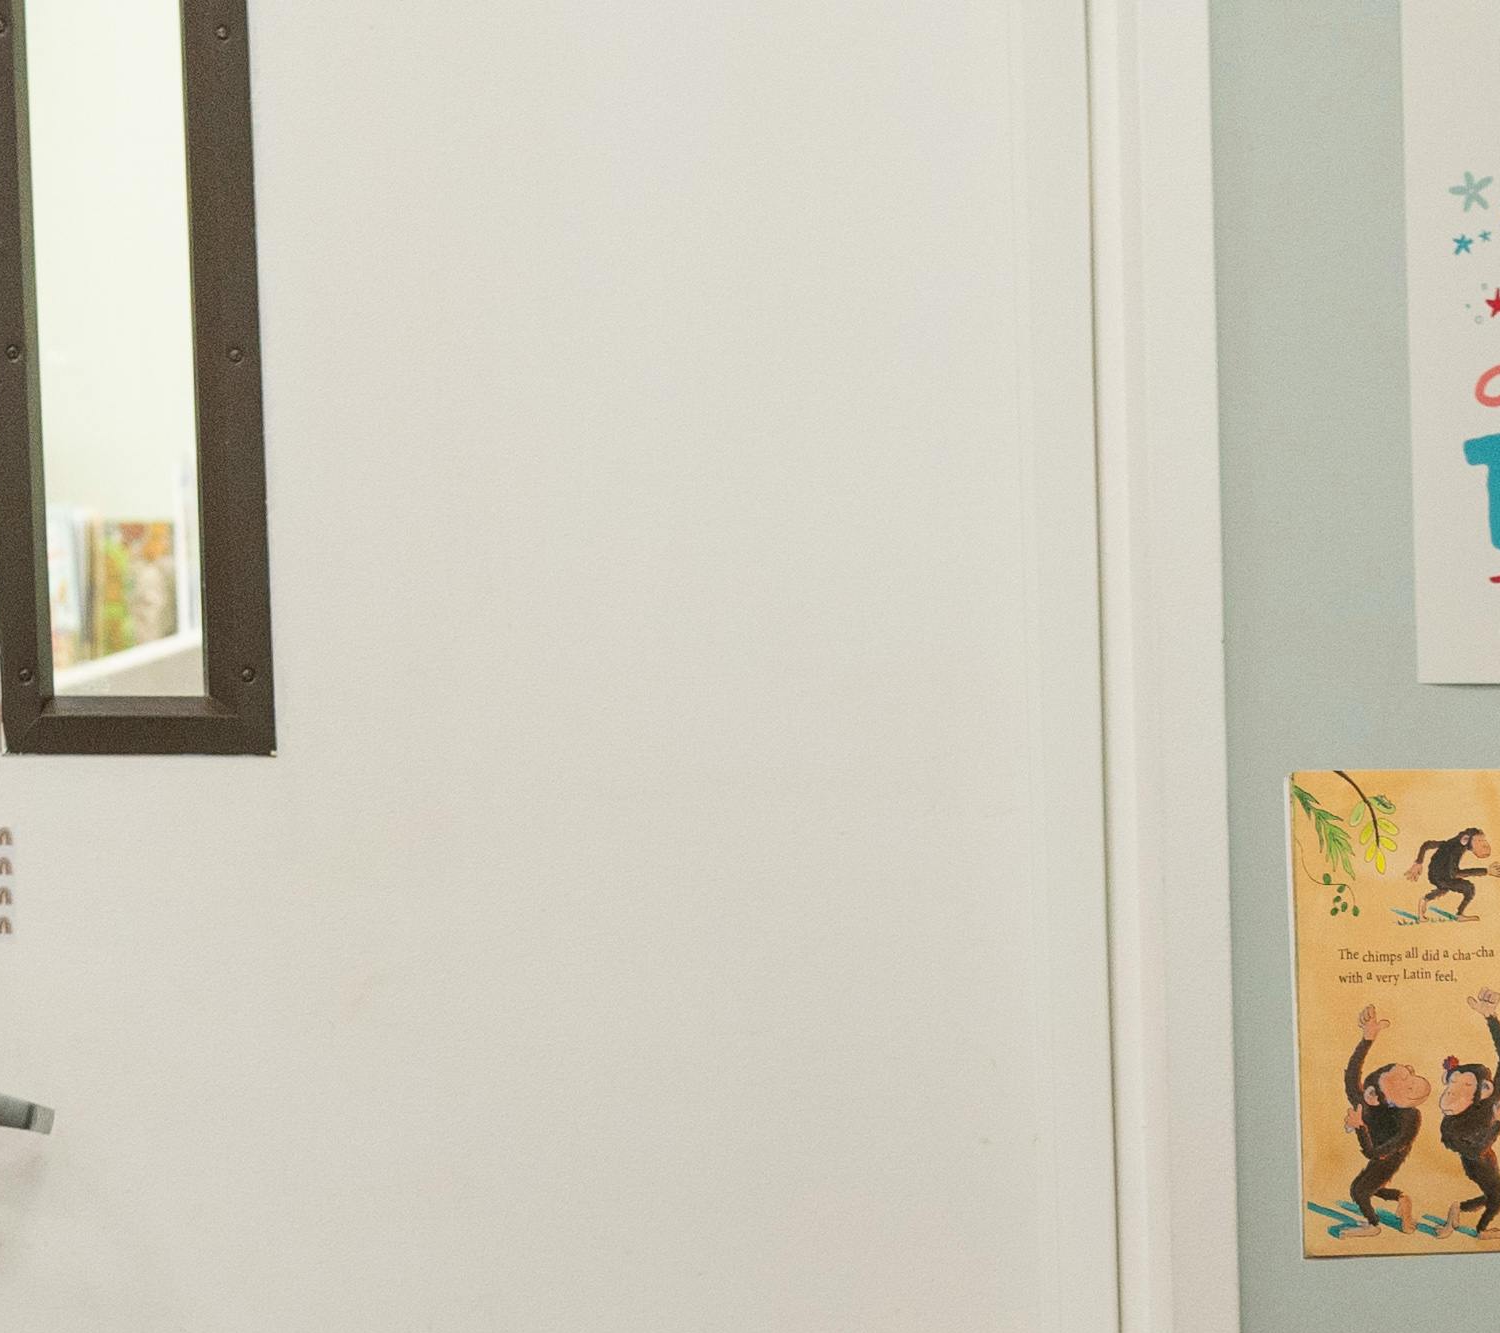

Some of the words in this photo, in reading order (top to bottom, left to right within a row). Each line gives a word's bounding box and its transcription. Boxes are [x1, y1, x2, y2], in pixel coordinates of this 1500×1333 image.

[1338, 948, 1359, 960] The
[1362, 950, 1402, 965] chimps
[1405, 947, 1418, 959] all
[1422, 949, 1440, 961] did
[1443, 950, 1449, 958] a
[1452, 945, 1494, 961] cha-cha
[1339, 971, 1363, 984] with
[1366, 972, 1373, 980] a
[1376, 973, 1399, 986] very
[1403, 968, 1431, 980] Latin
